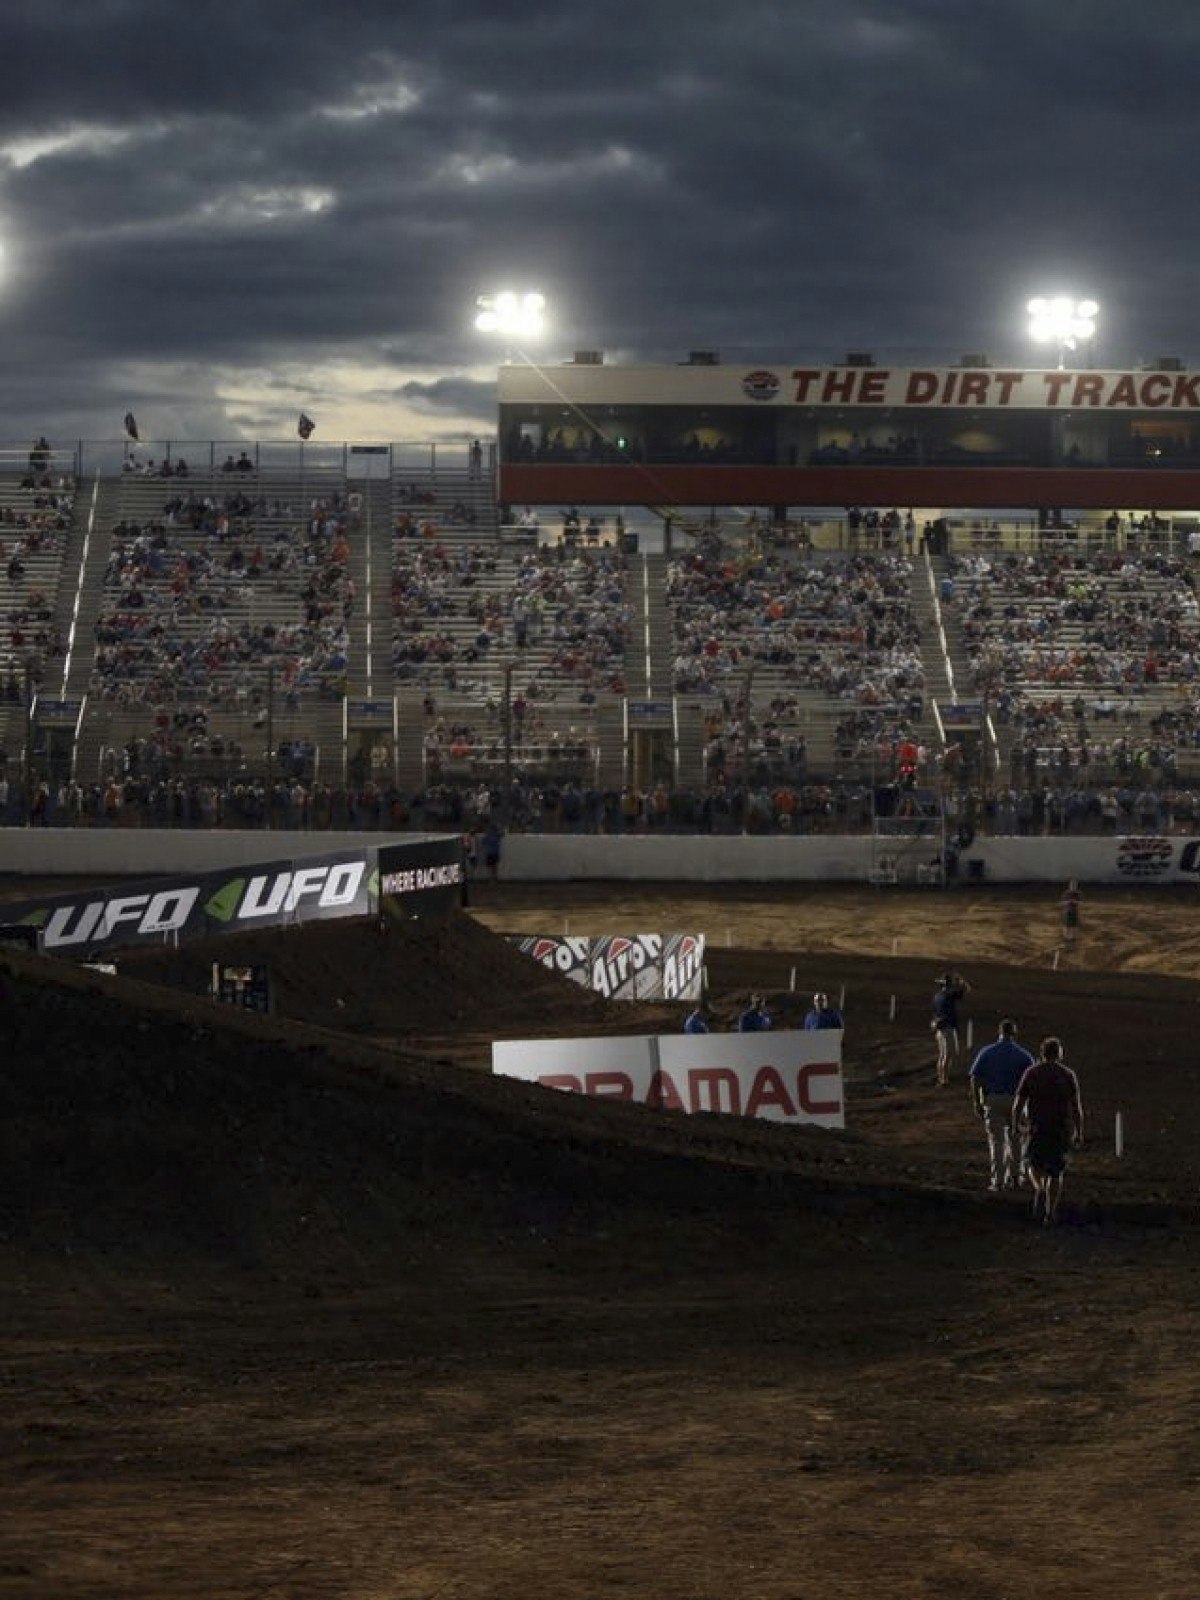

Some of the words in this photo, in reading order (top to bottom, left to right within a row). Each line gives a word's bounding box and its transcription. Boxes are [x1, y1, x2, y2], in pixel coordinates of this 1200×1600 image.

[791, 371, 890, 403] THE
[905, 372, 1024, 404] DIRT
[238, 861, 366, 918] UFO
[382, 871, 416, 894] WHERE
[44, 887, 199, 948] UFO
